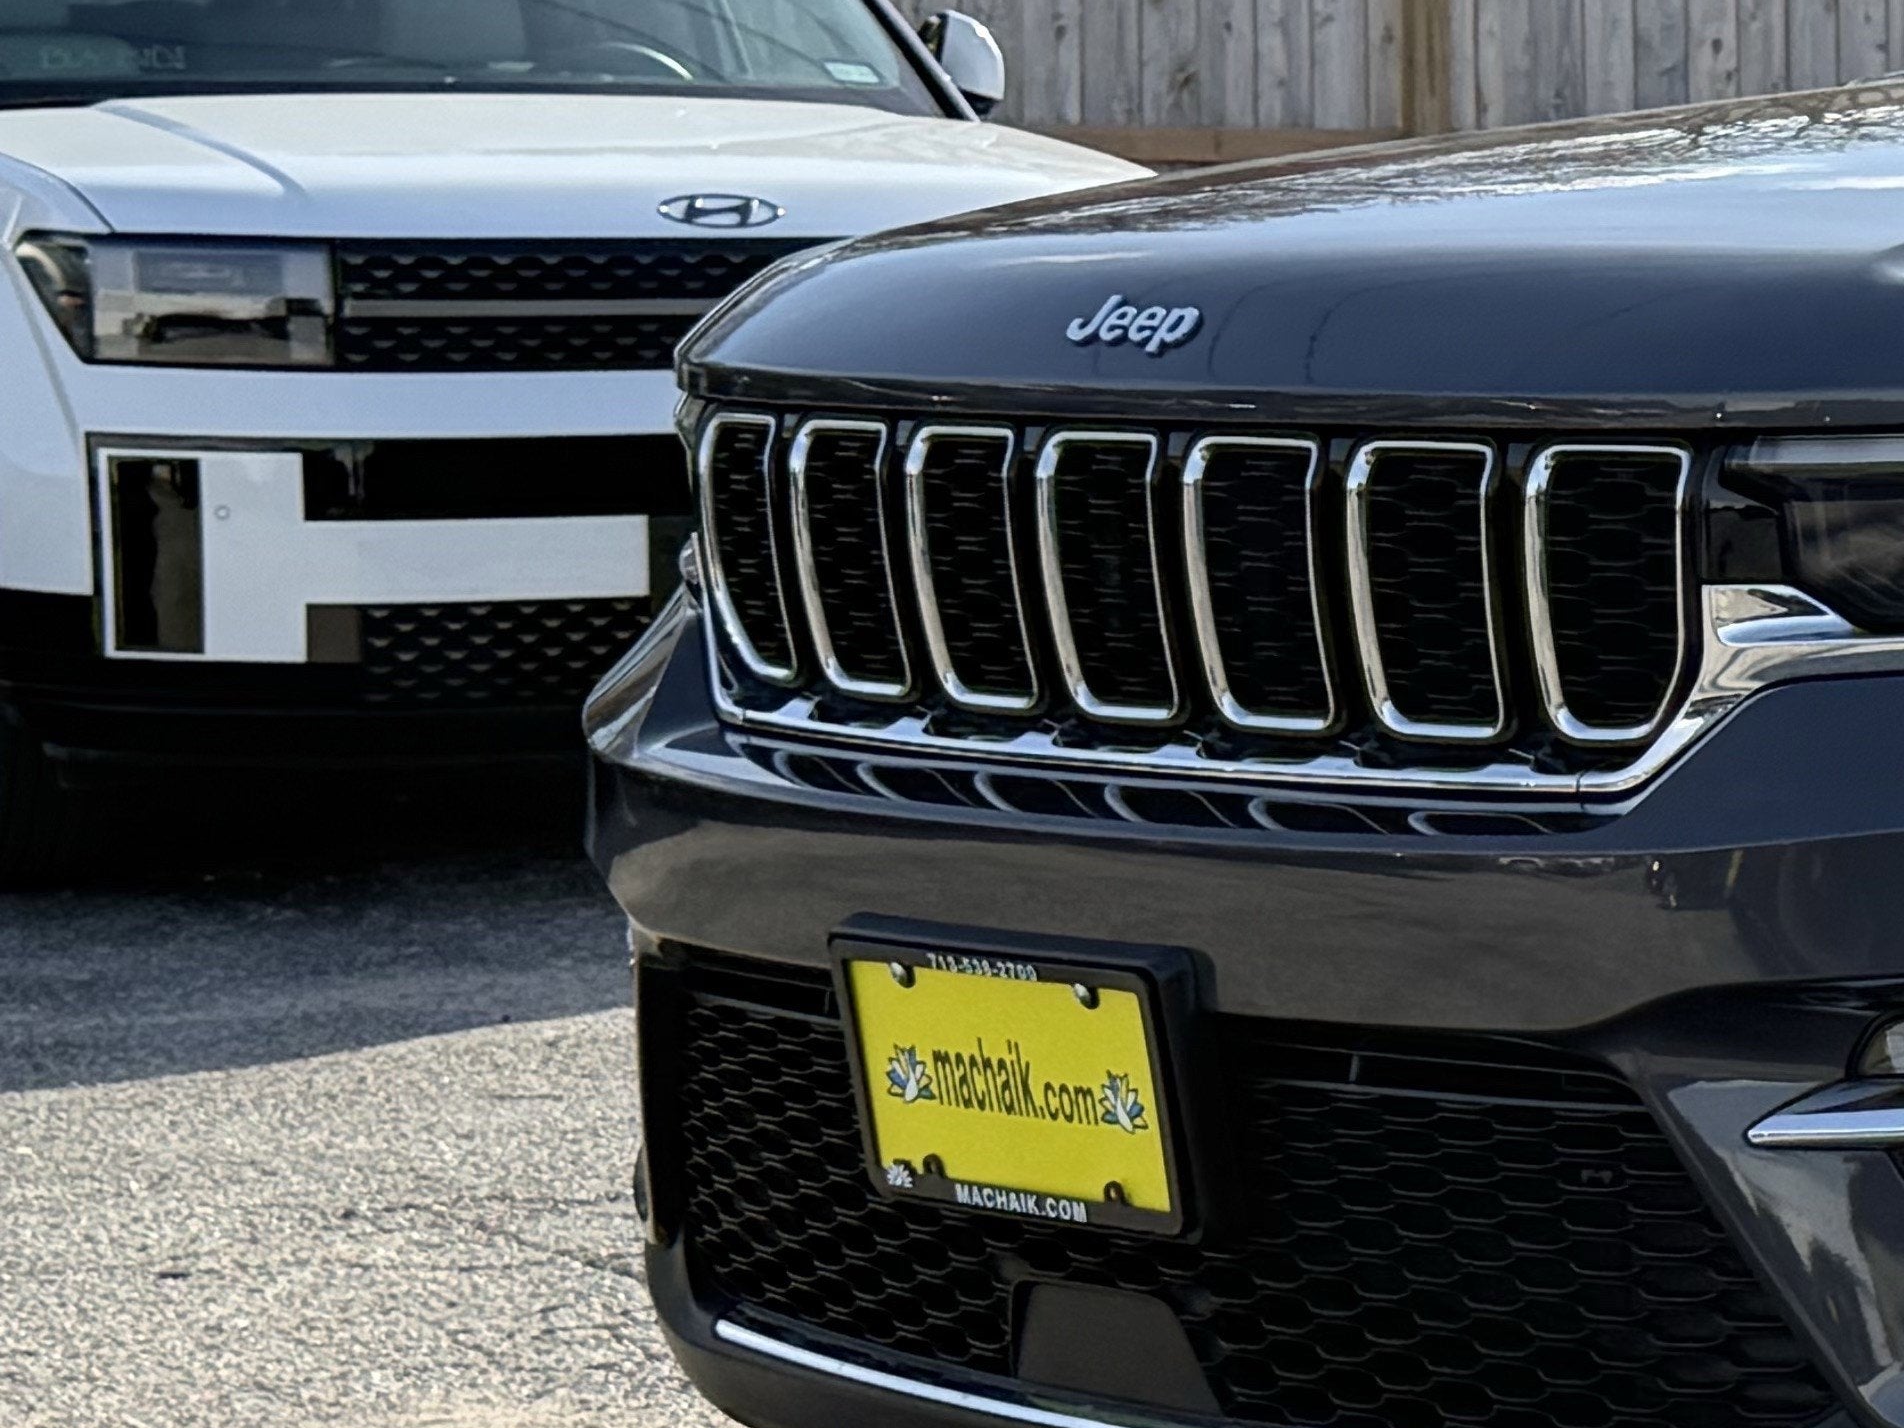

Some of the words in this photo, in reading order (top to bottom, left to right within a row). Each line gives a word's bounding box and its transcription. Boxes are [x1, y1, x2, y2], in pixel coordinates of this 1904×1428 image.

[1065, 294, 1201, 354] Jeep
[931, 1036, 1100, 1127] machaik.com
[955, 1182, 1088, 1223] MACHAIK.COM
